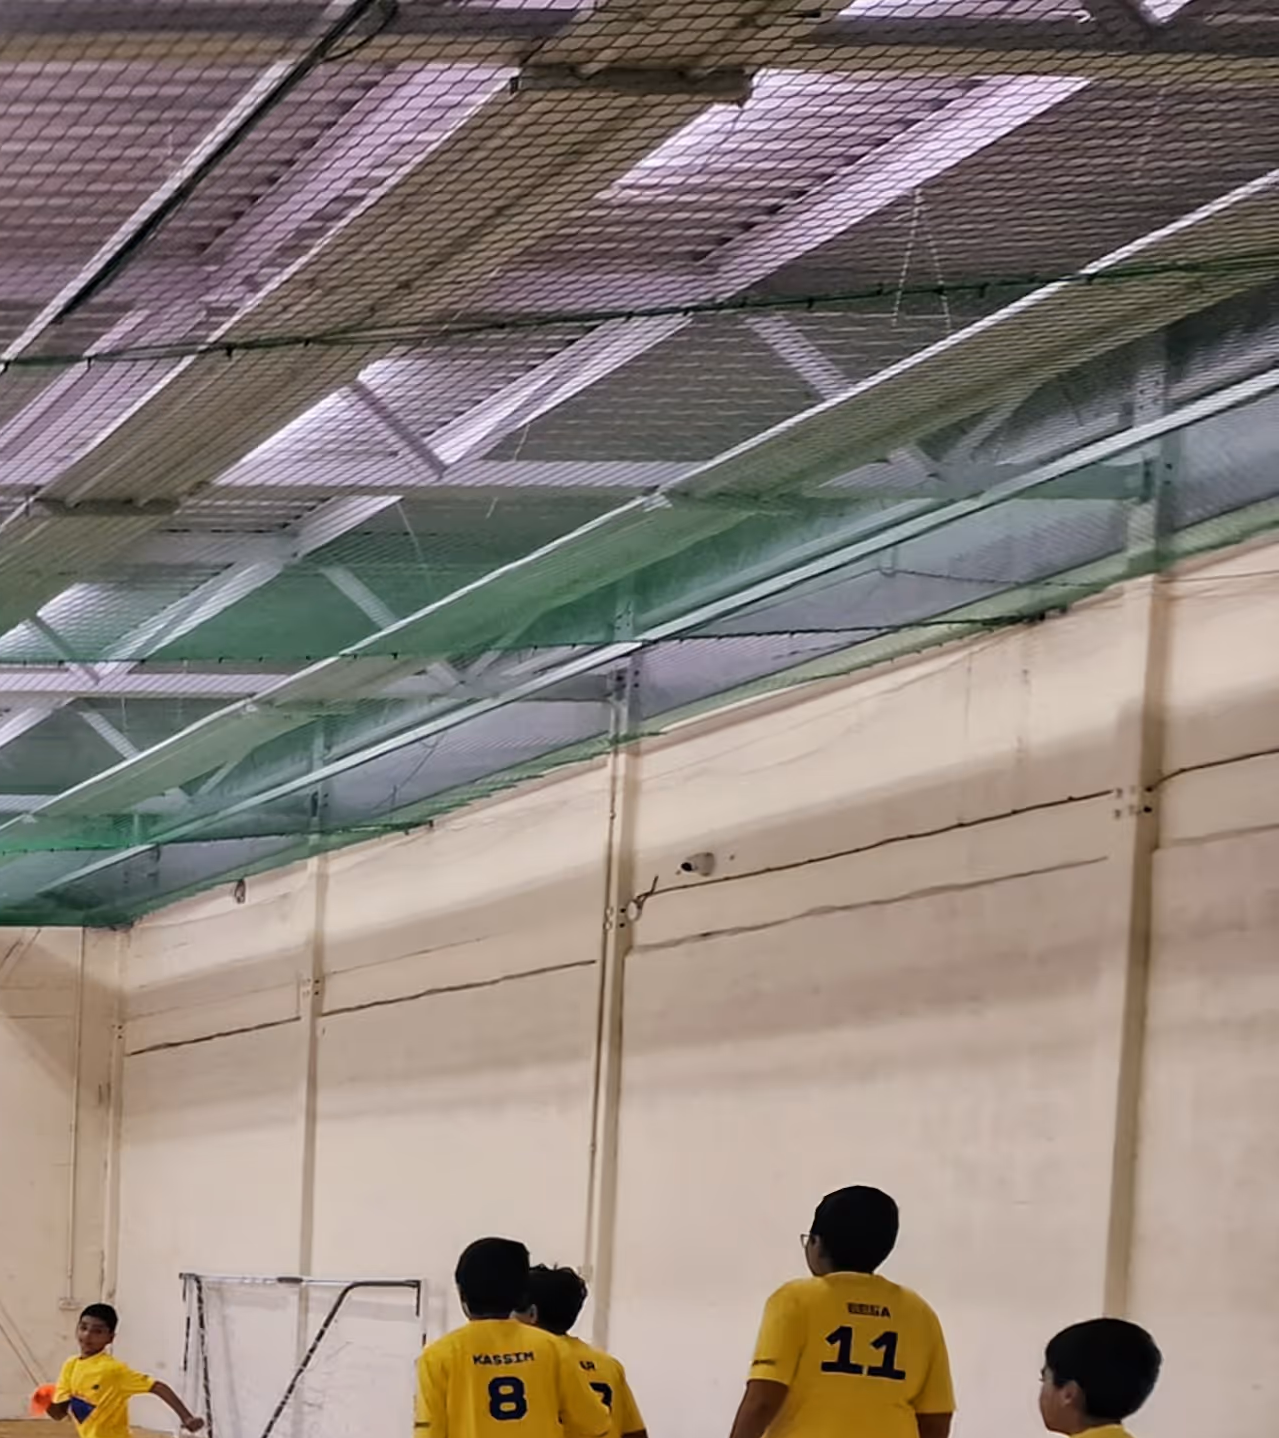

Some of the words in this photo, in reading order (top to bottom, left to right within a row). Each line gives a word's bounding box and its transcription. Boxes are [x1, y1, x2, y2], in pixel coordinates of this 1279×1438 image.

[472, 1350, 535, 1365] KASSIM
[821, 1325, 906, 1380] 11
[487, 1376, 528, 1421] 8
